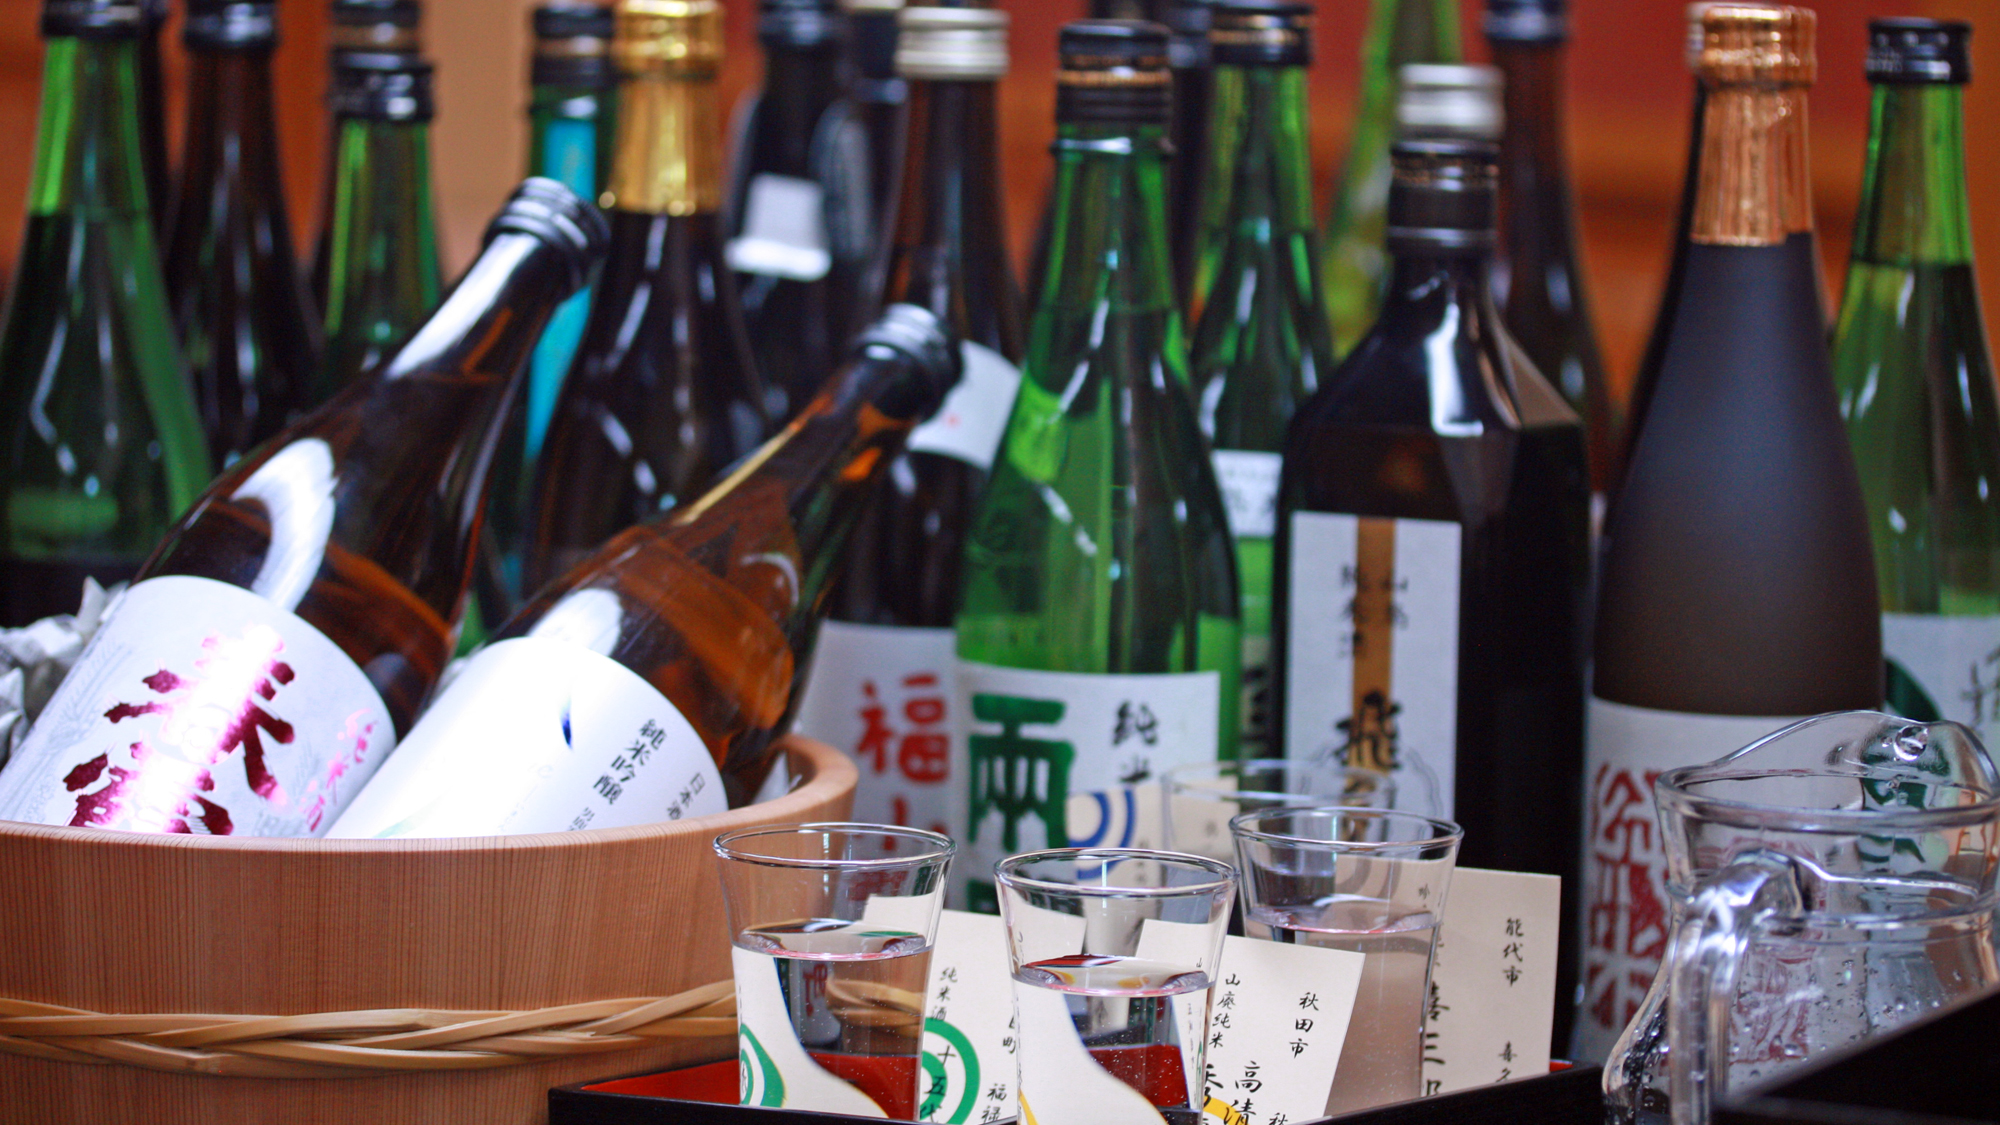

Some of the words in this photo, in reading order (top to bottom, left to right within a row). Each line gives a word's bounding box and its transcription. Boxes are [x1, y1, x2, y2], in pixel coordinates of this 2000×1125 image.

[1502, 916, 1525, 987] 能代市
[929, 966, 958, 1022] 純米酒
[1208, 972, 1241, 1049] 山廃純米
[1288, 991, 1320, 1059] 秋田市
